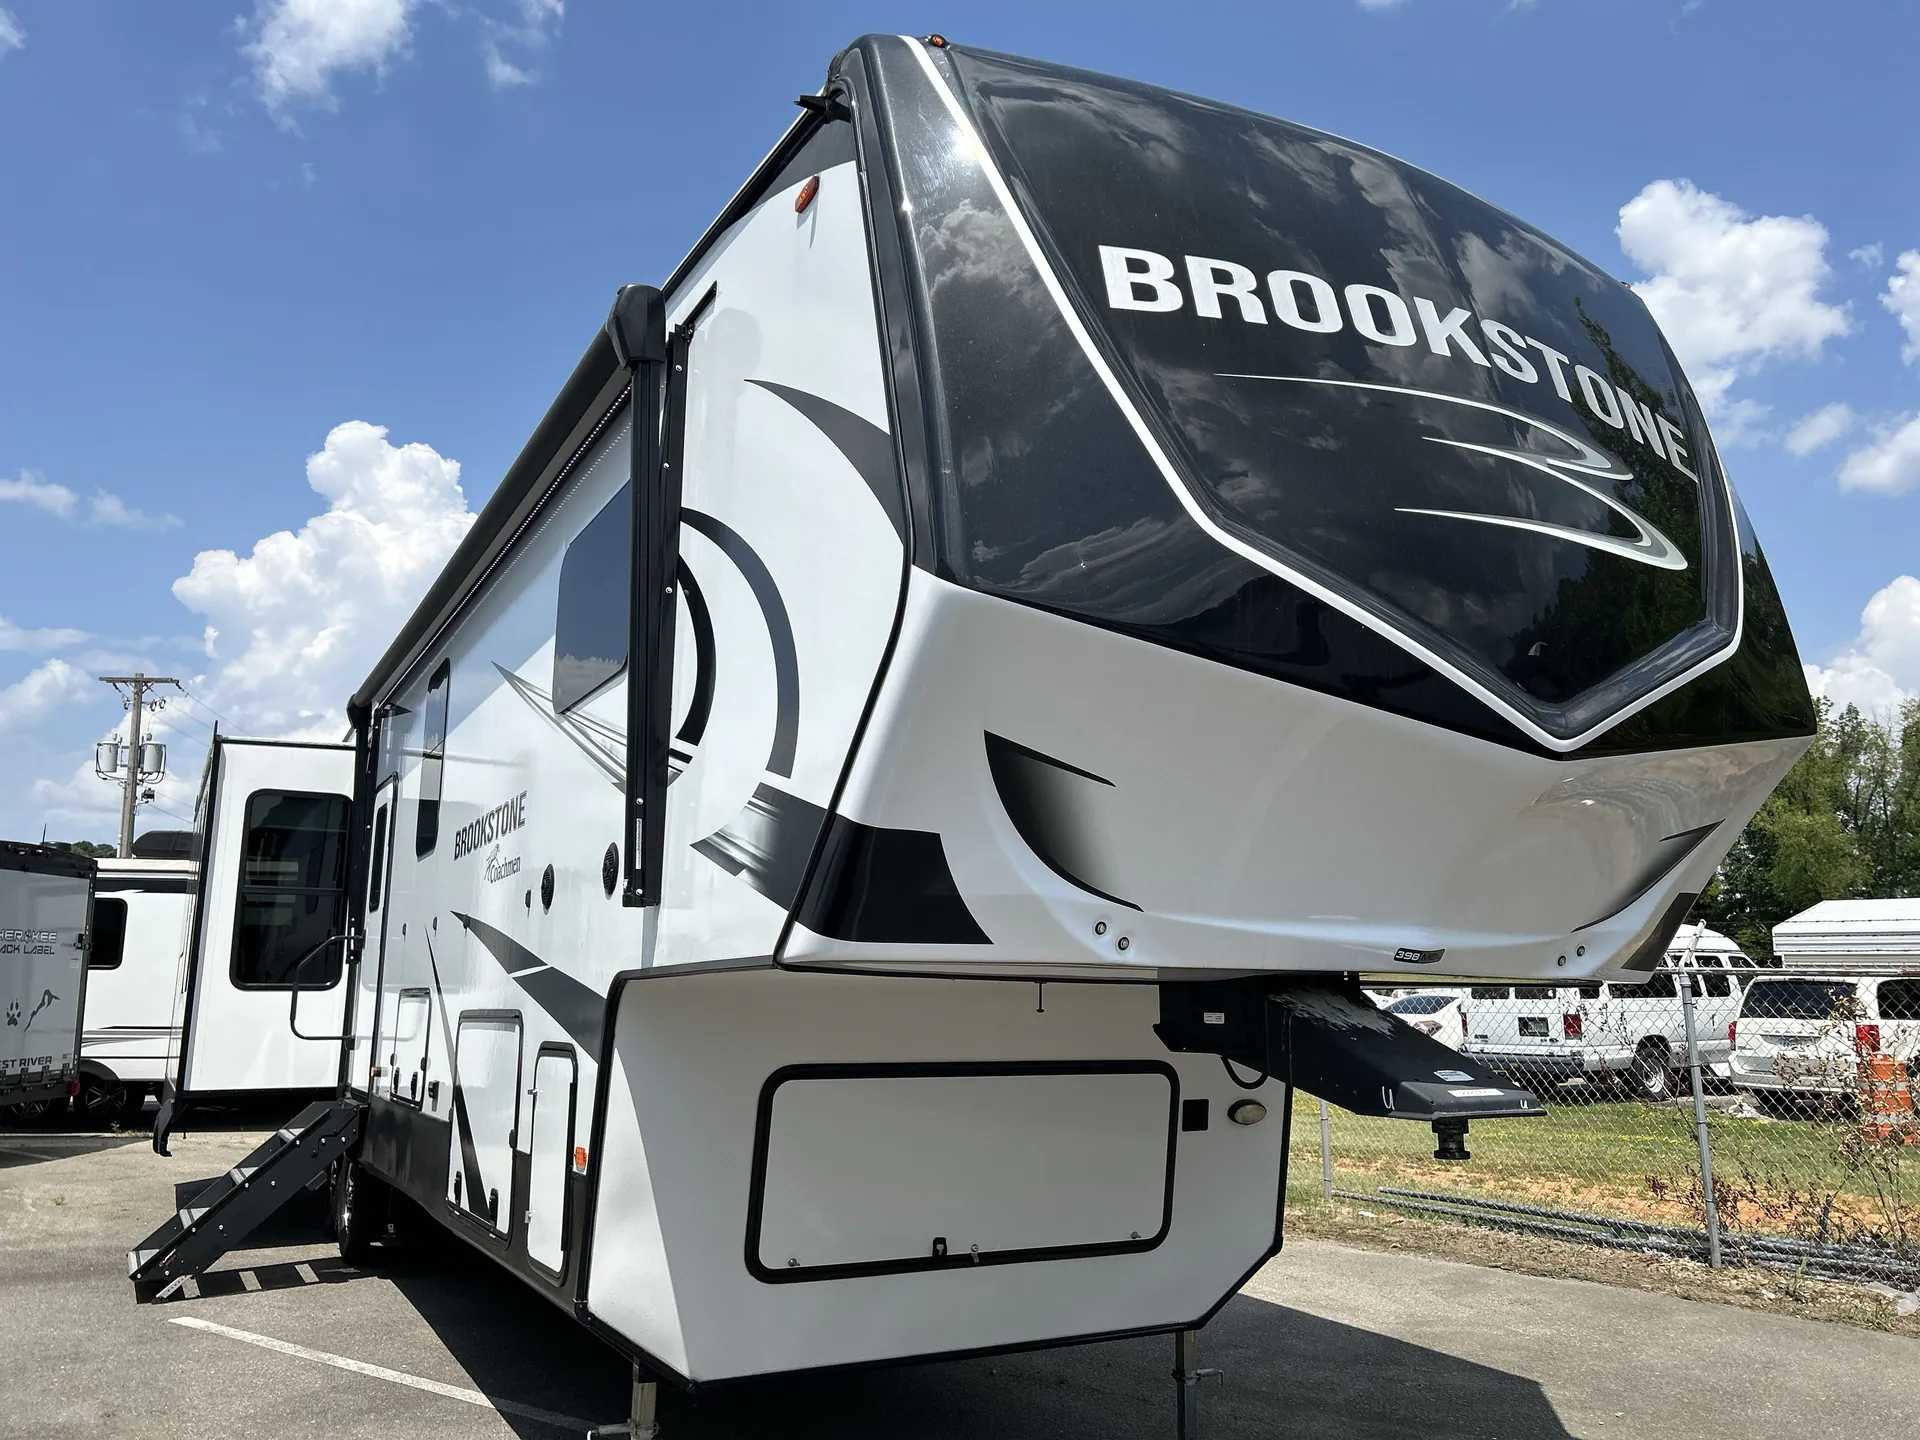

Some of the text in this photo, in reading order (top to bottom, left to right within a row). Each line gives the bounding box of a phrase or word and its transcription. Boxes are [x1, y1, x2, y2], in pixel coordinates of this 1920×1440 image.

[1098, 245, 1698, 484] BROOKSTONE
[454, 790, 527, 861] BROOKSTONE
[490, 856, 521, 884] Coachmen
[24, 945, 55, 955] LABEL
[1395, 950, 1420, 961] 398
[0, 1059, 17, 1069] ST
[19, 1055, 52, 1067] RIVER
